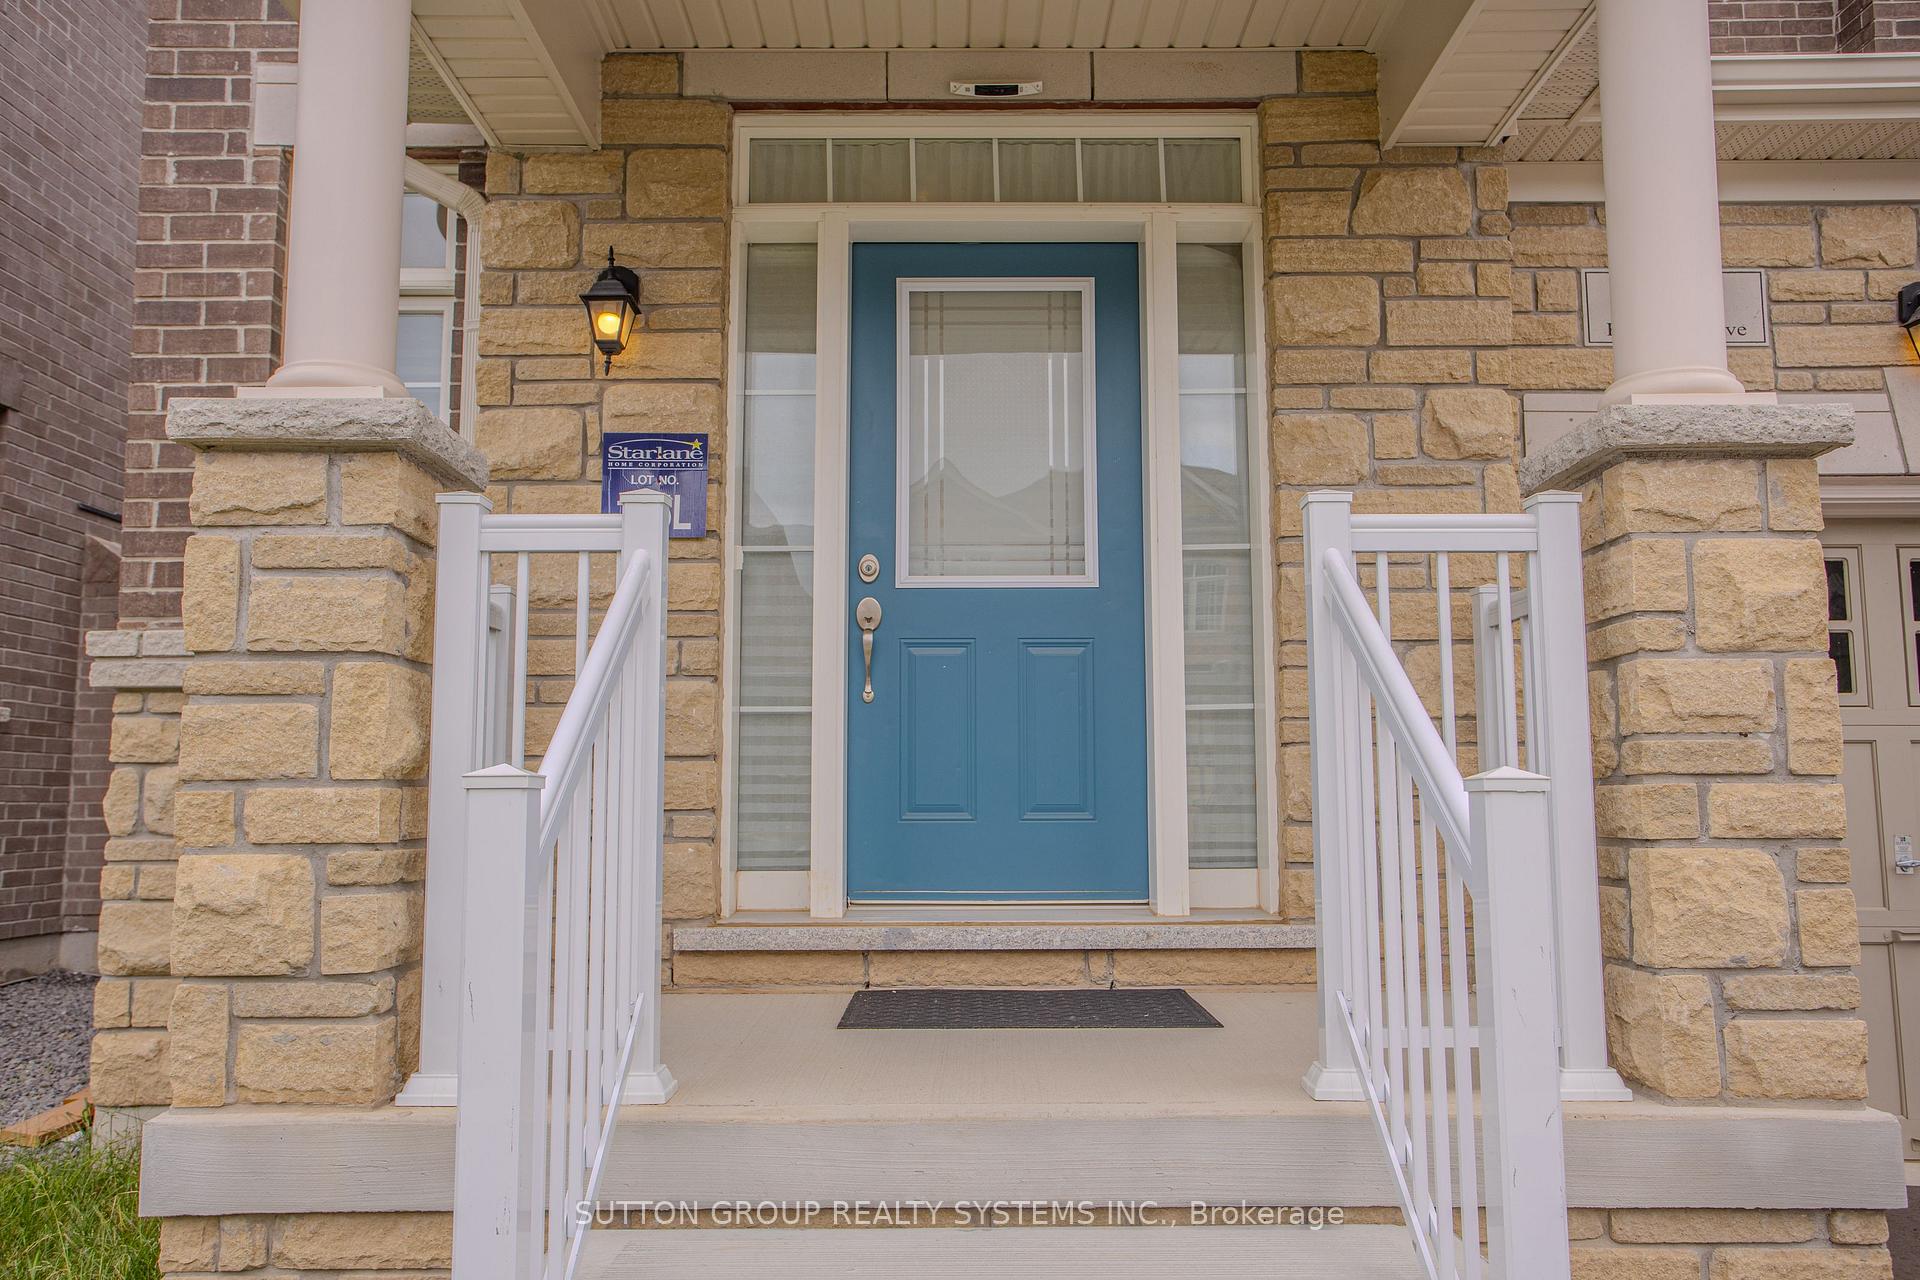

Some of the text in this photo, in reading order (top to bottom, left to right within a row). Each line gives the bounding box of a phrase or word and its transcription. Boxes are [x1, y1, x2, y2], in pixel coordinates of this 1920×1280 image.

[607, 445, 704, 460] Starlane
[631, 475, 679, 485] LOT NO.
